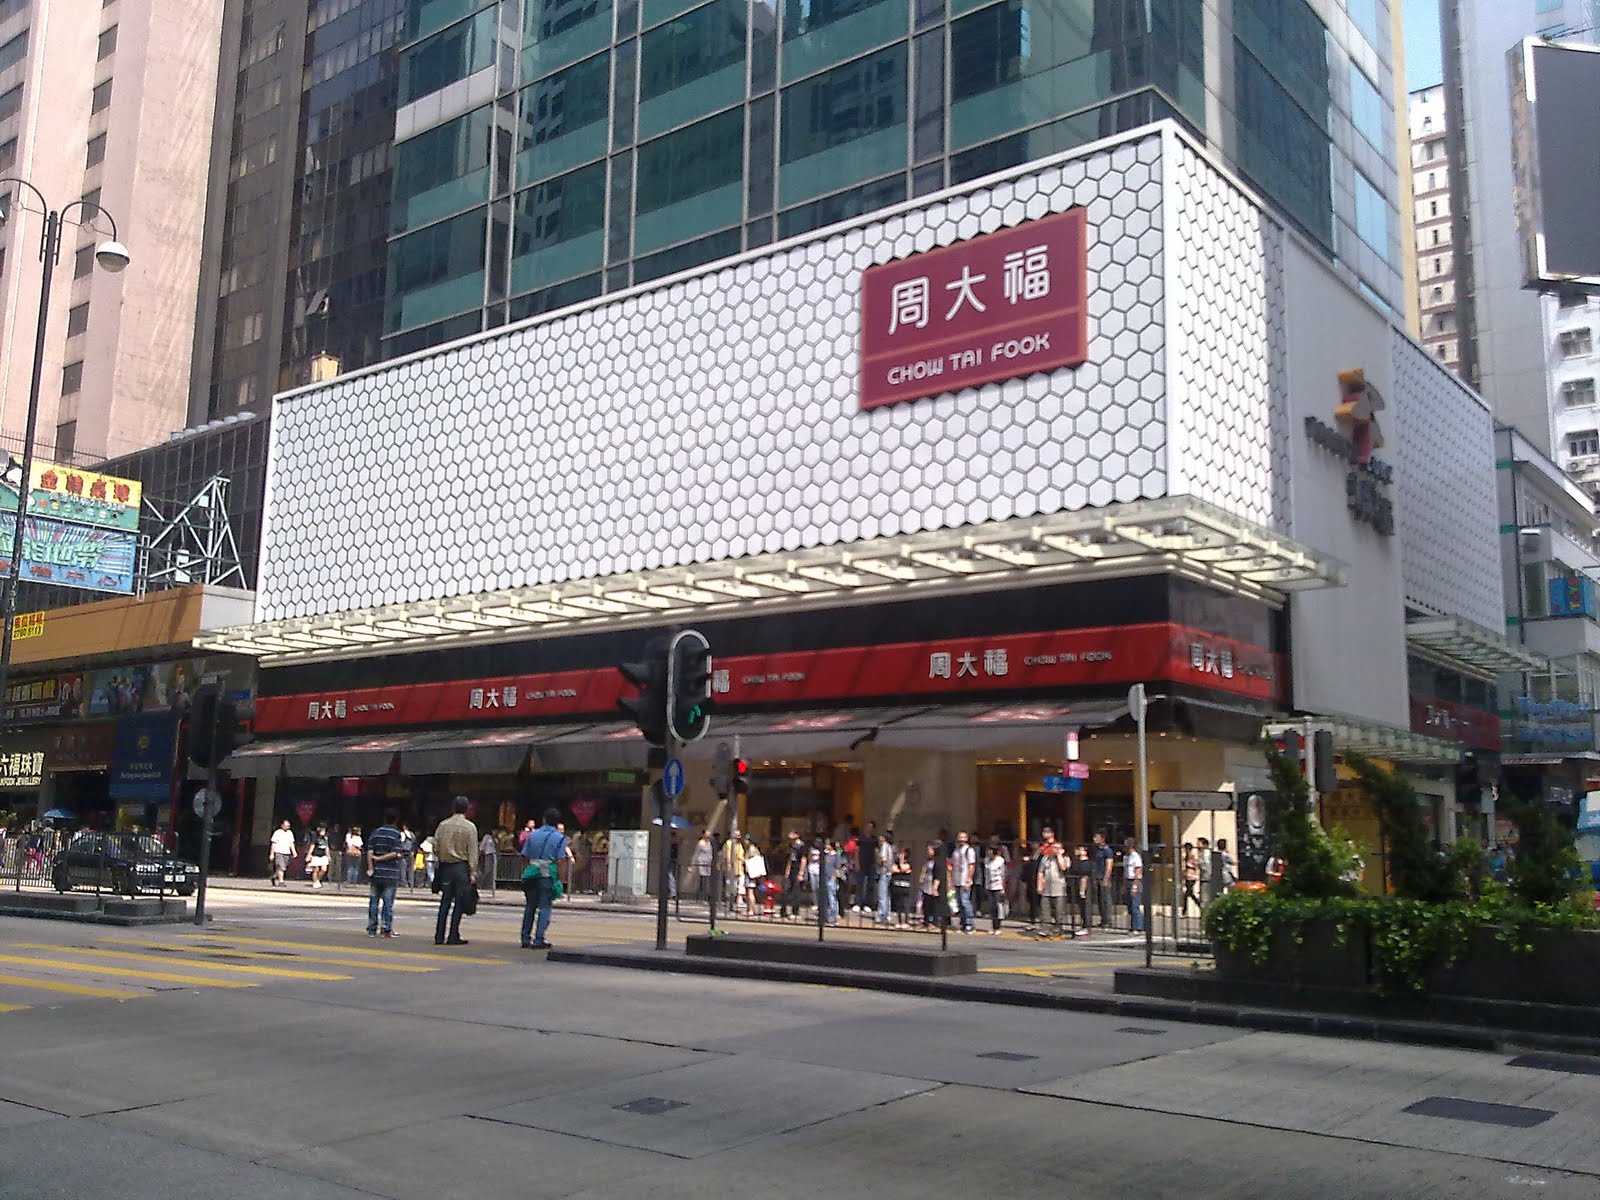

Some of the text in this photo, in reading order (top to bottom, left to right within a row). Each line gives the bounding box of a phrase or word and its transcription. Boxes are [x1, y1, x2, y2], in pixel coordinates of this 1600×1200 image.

[888, 245, 1050, 335] 周大福
[887, 332, 1051, 385] CHOW TAI FOOK
[929, 649, 1008, 678] 周大福
[308, 700, 347, 720] 周大福
[469, 686, 517, 709] 周大福
